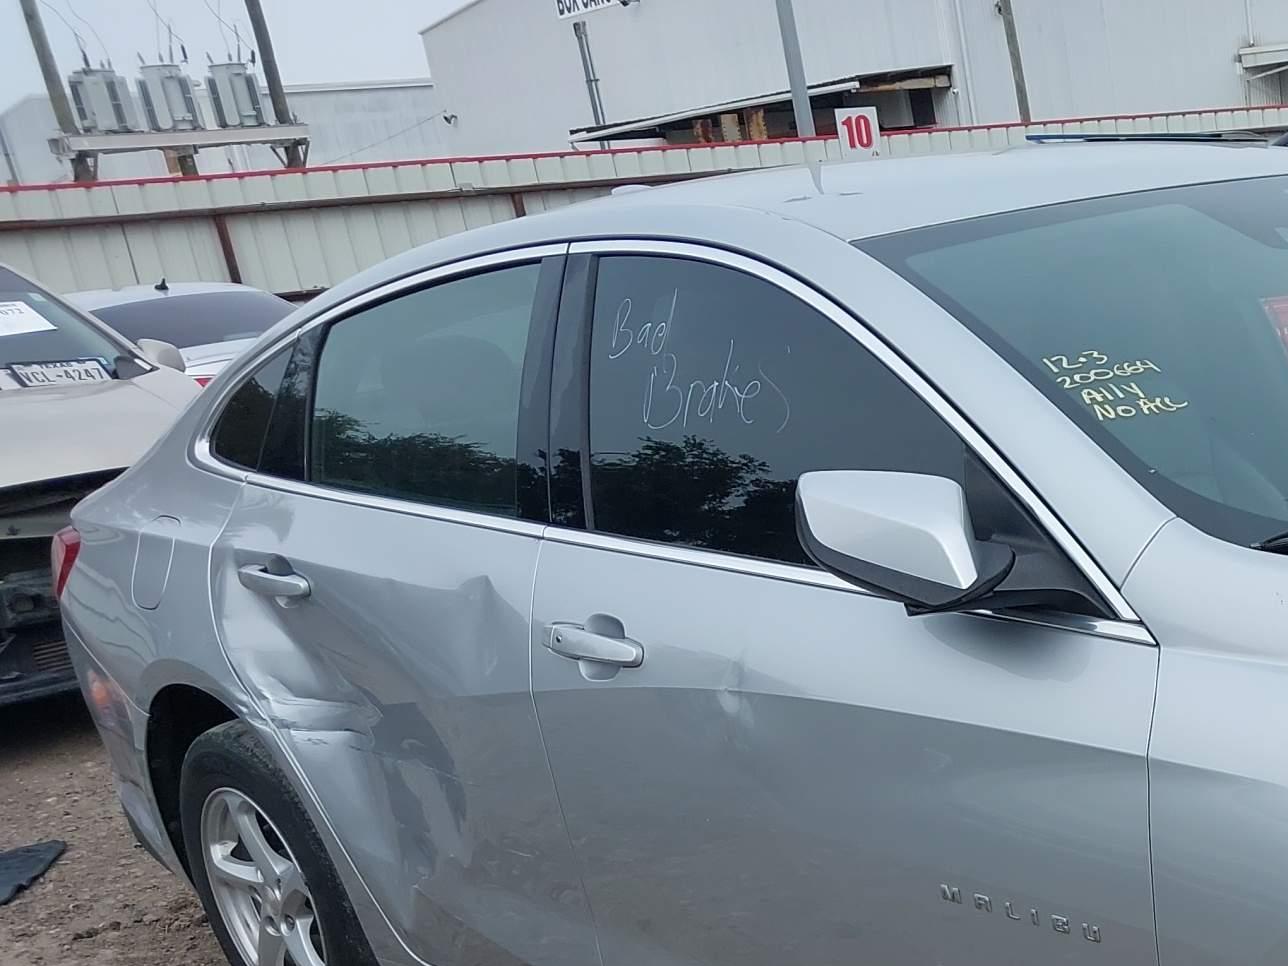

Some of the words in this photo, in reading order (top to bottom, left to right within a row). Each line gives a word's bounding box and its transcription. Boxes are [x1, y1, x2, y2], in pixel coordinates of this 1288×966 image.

[841, 114, 873, 149] 10
[608, 286, 679, 359] Bad
[643, 339, 791, 433] Brakes
[940, 883, 1101, 944] MALIBU
